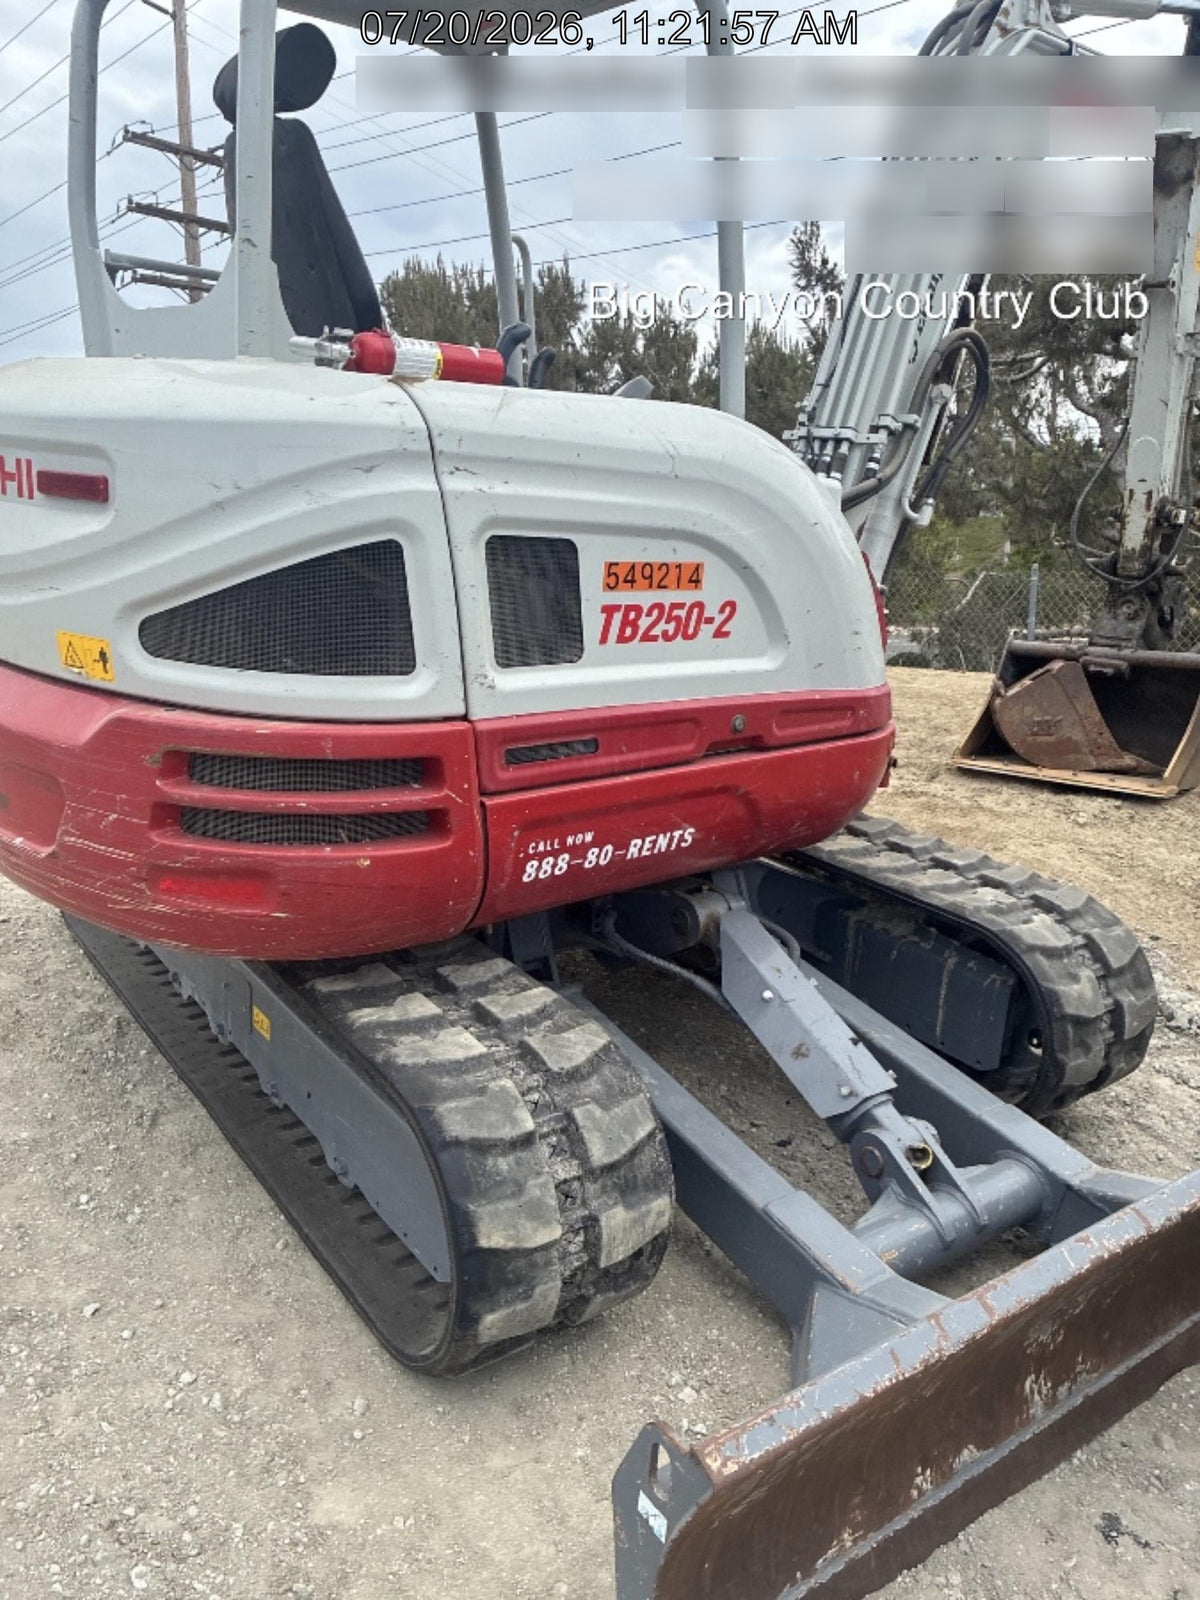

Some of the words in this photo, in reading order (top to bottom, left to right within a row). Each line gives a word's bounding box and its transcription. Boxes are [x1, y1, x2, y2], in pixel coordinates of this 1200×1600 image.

[605, 562, 701, 591] 549214
[598, 600, 738, 645] TB250-2
[522, 827, 696, 883] 888-80-RENTS
[528, 838, 560, 854] CALL
[566, 831, 595, 847] NOW
